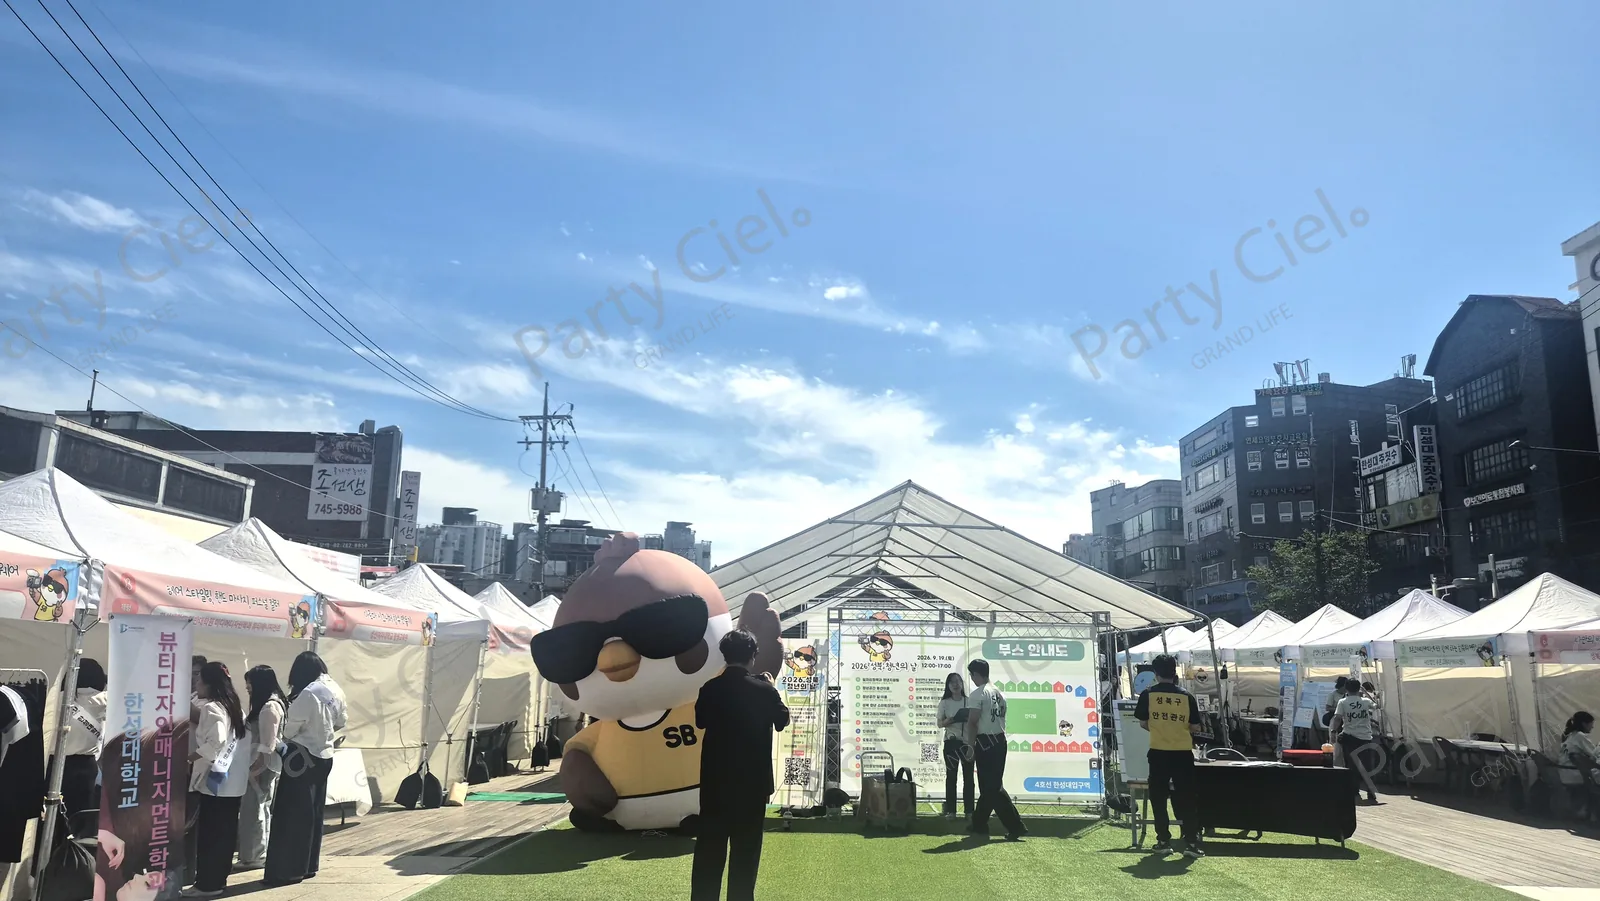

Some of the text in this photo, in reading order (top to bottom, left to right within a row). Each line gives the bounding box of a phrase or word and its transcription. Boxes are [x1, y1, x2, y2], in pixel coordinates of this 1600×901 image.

[314, 504, 362, 515] 745-5988
[166, 585, 184, 596] 헤어
[215, 590, 227, 604] 핸드
[998, 643, 1068, 657] 부스 안내도
[1156, 696, 1182, 706] 성북구
[1152, 712, 1186, 722] 안전관리
[662, 724, 697, 748] SB
[118, 692, 144, 809] 한성대학교
[146, 631, 178, 891] 뷰티디자인매니지먼트학과
